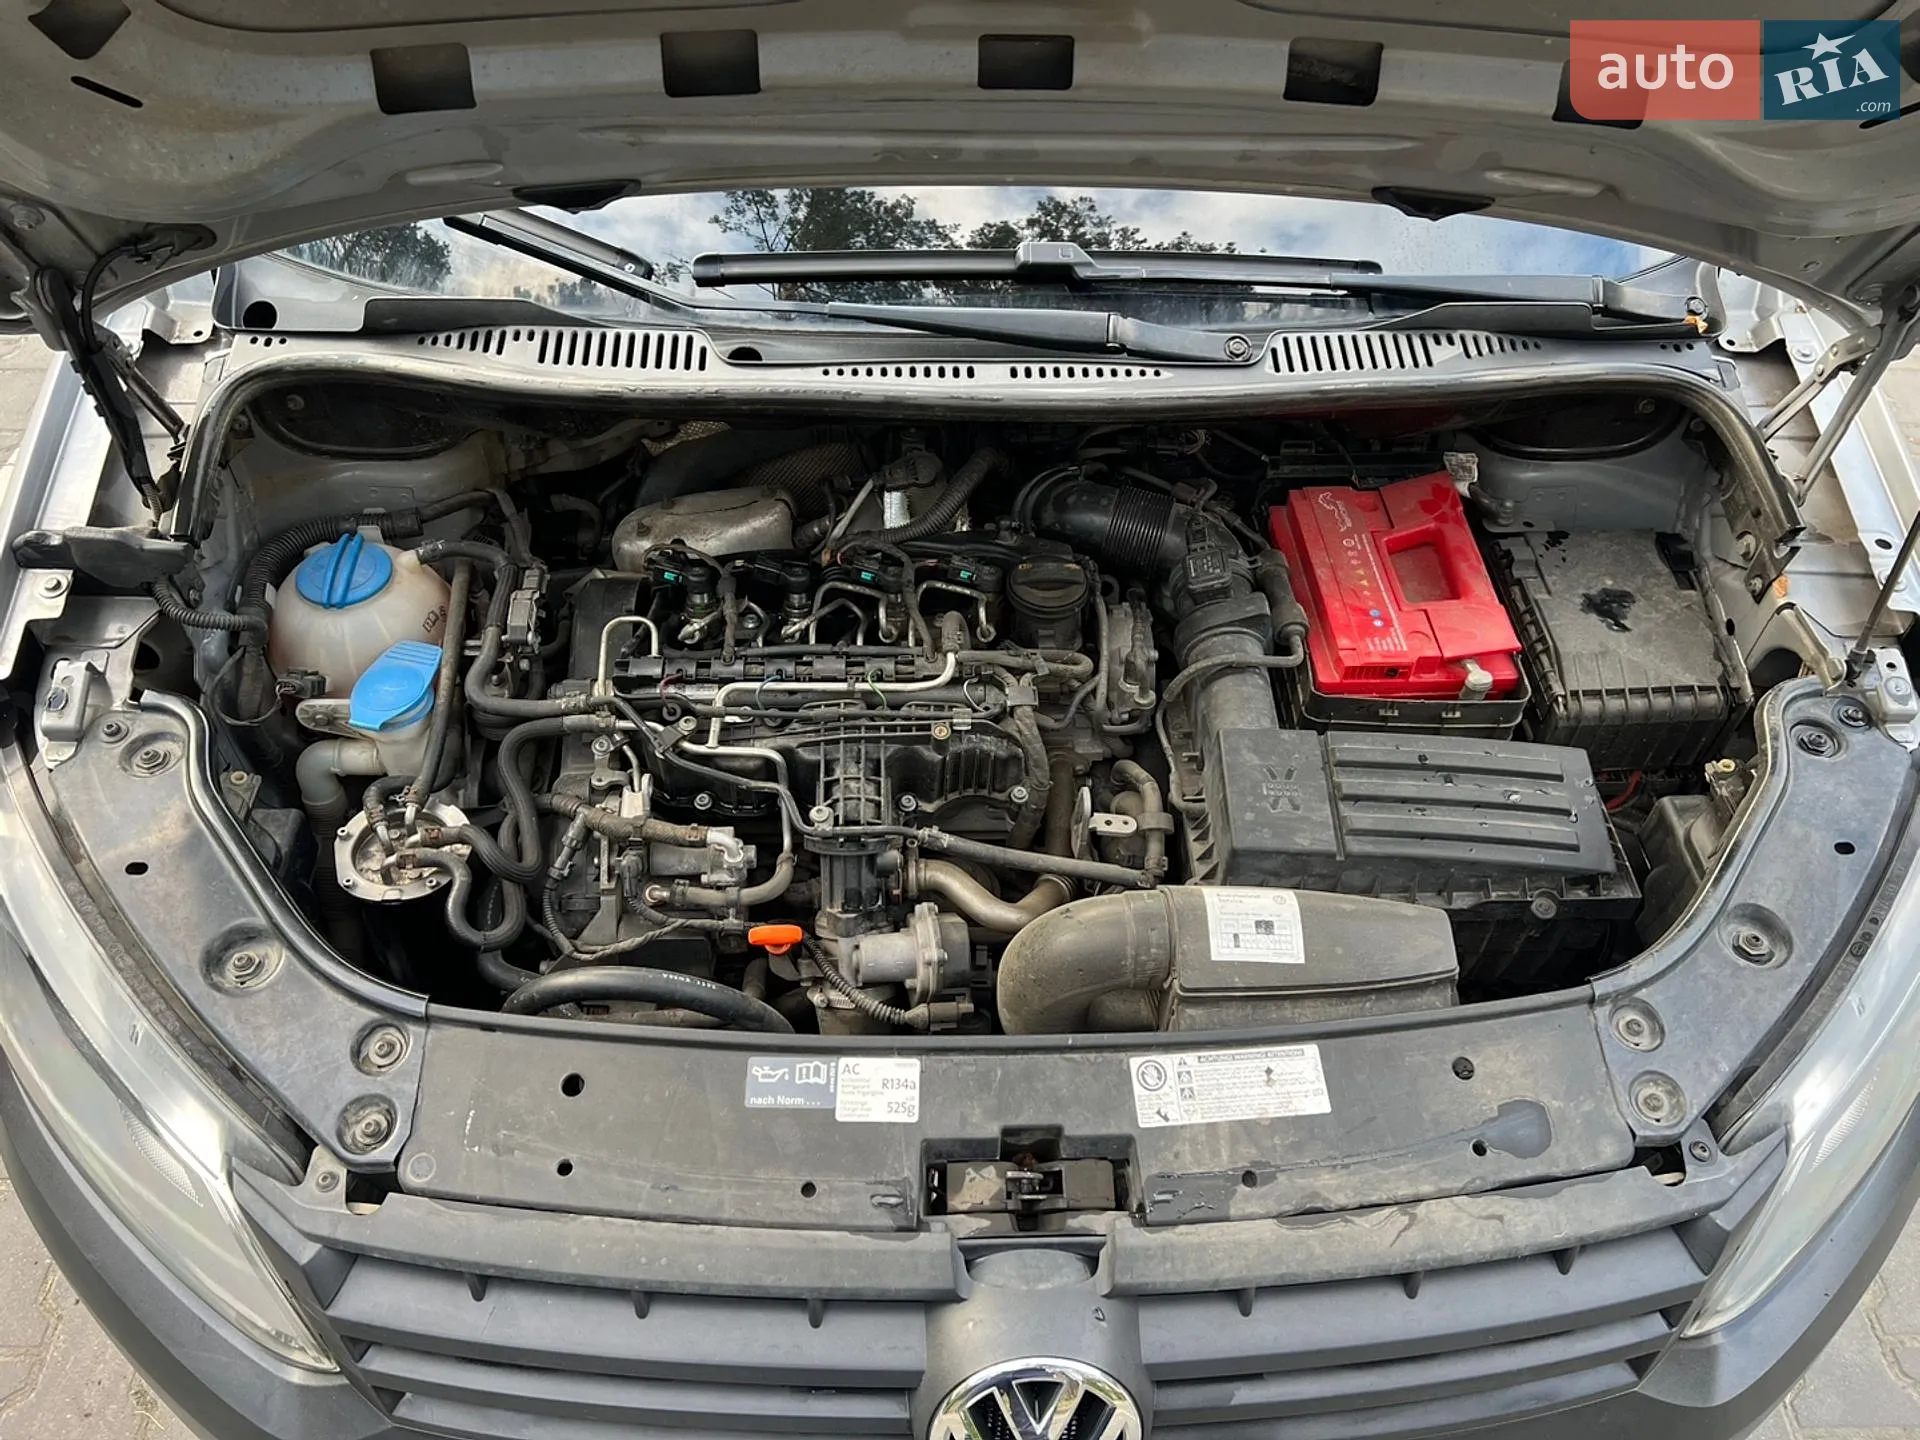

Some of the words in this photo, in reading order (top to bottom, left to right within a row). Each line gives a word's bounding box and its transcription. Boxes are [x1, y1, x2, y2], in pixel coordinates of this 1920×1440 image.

[841, 1063, 861, 1076] AC
[881, 1078, 917, 1091] R134a
[749, 1095, 775, 1105] nach
[886, 1101, 917, 1118] 525g
